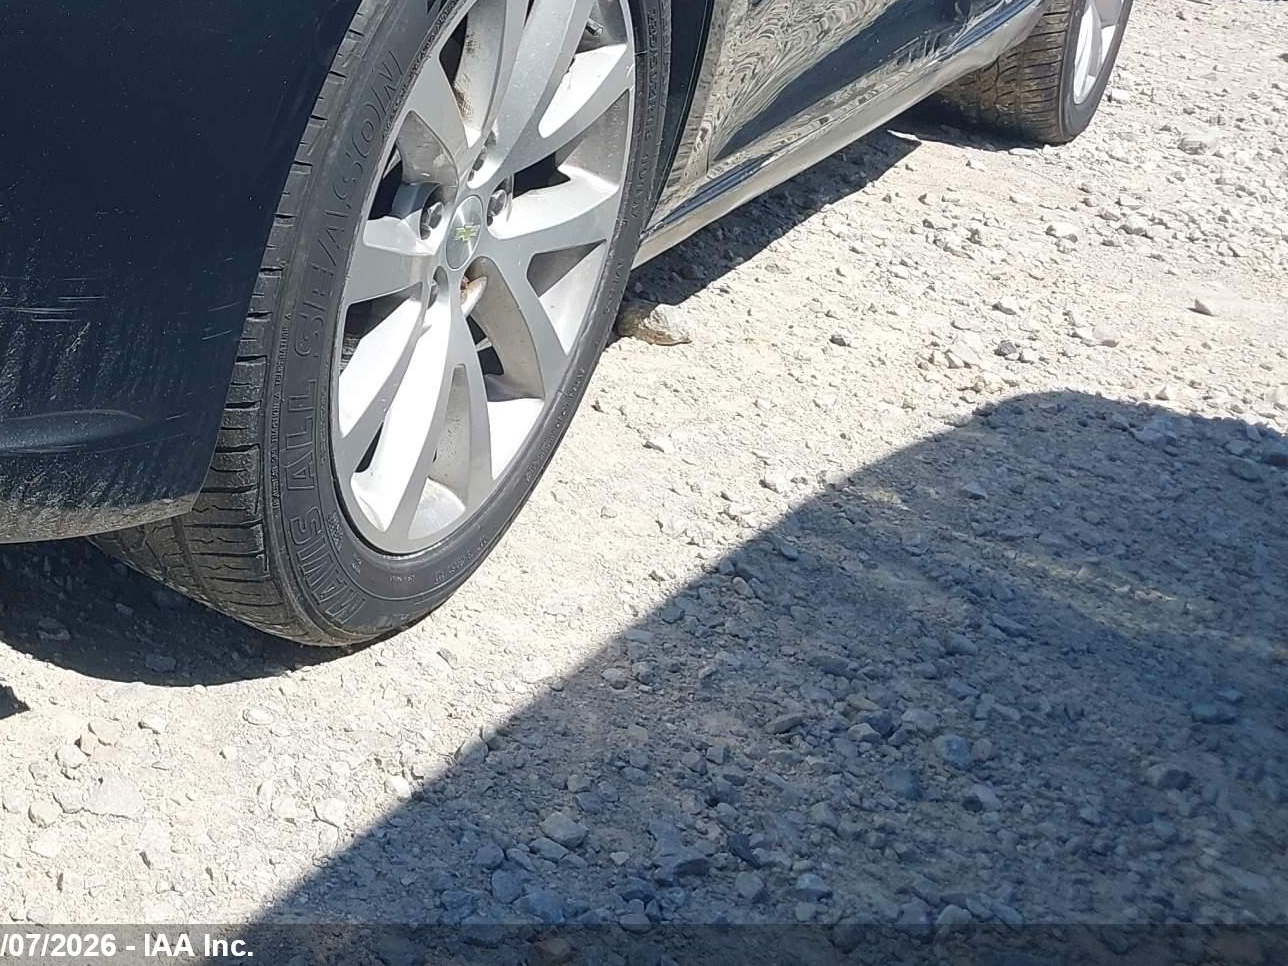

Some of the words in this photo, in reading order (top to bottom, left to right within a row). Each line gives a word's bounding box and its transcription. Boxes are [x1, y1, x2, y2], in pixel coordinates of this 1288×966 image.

[295, 50, 404, 359] SEASON
[282, 378, 319, 491] ALL
[288, 505, 366, 625] MAVIS
